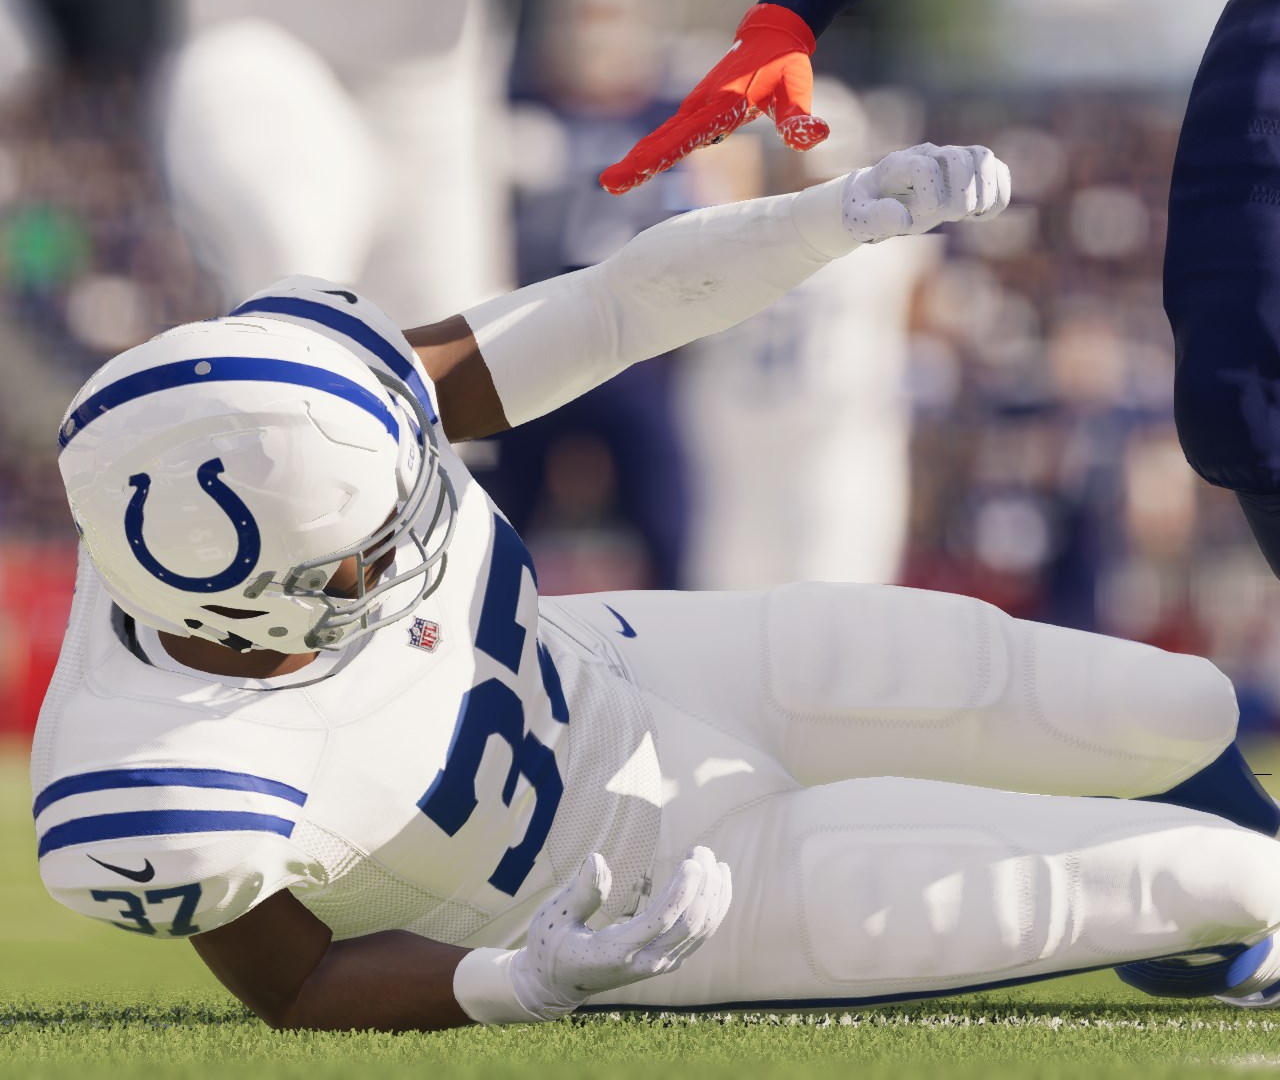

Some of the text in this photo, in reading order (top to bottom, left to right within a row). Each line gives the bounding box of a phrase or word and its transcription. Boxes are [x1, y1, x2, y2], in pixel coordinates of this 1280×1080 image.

[421, 625, 437, 648] NFL
[417, 512, 570, 898] 37
[90, 882, 203, 937] 37
